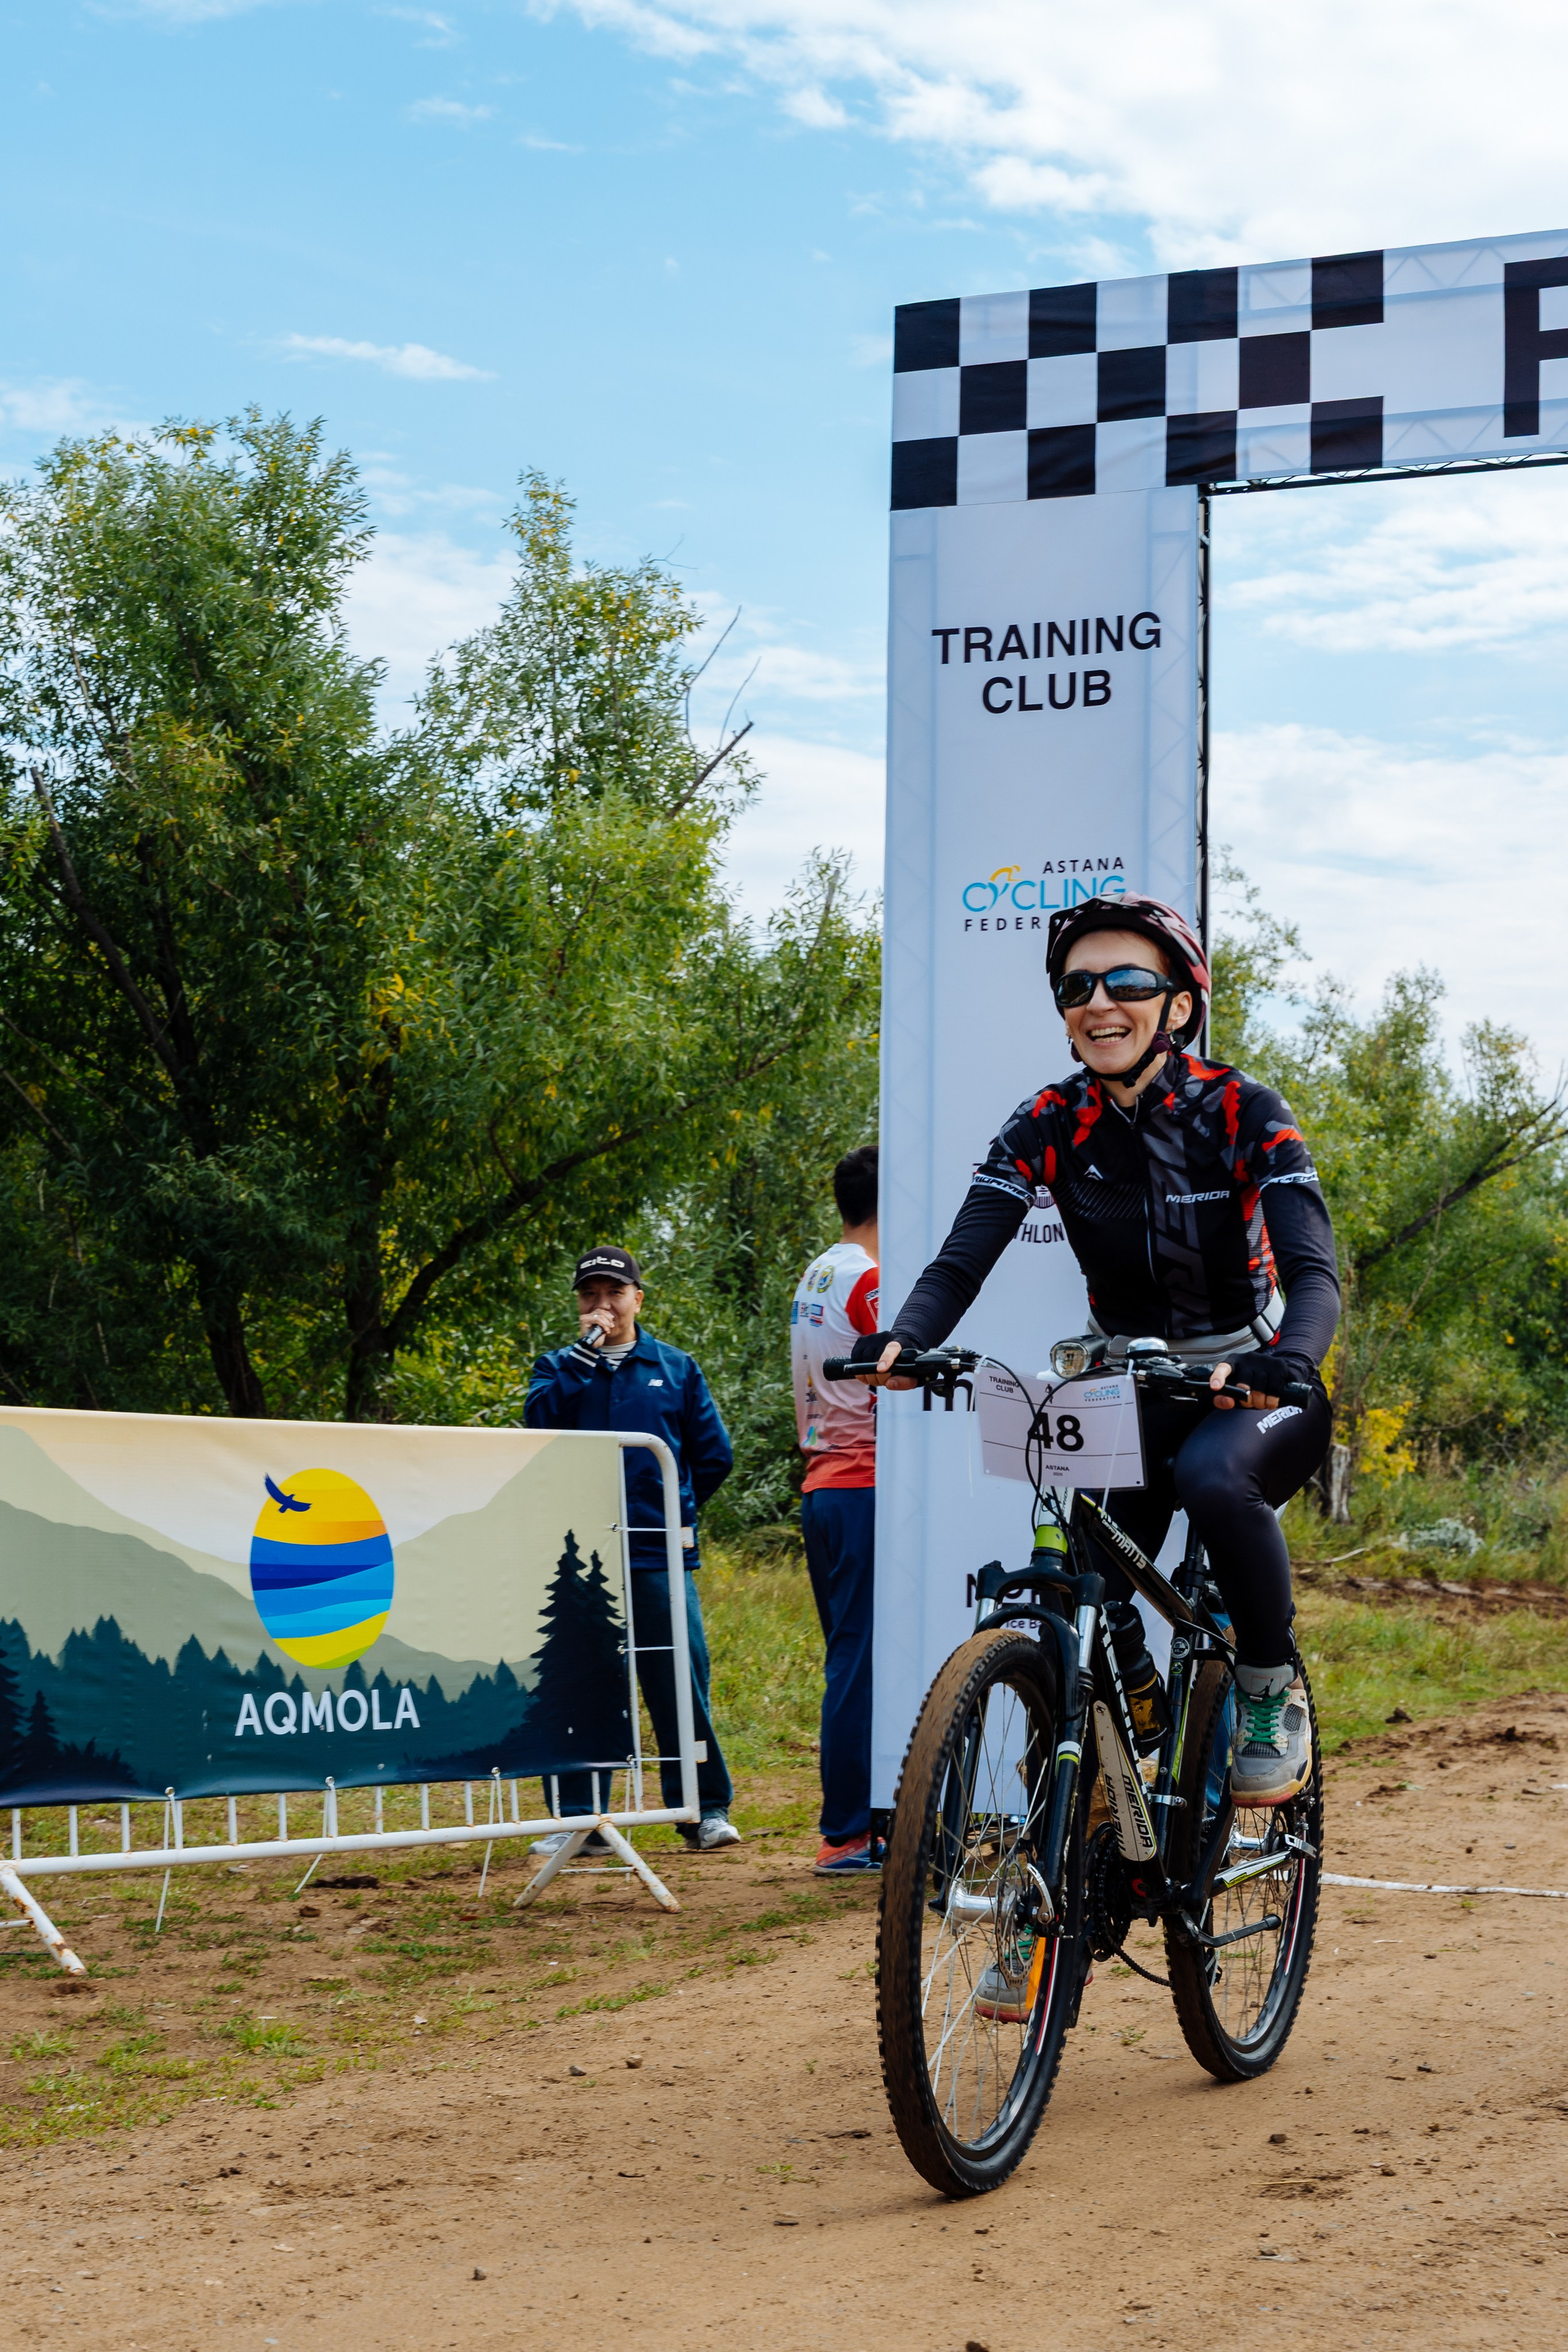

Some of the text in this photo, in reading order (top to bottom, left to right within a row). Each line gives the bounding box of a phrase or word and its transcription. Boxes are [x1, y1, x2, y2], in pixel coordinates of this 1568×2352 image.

[931, 611, 1162, 665] TRAINING
[982, 669, 1112, 714] CLUB
[1042, 857, 1124, 874] ASTANA
[962, 875, 1126, 912] CYCLING
[964, 916, 1049, 932] FEDER
[1166, 1191, 1230, 1204] MERIDA
[989, 1376, 1020, 1388] TRAINING
[996, 1384, 1014, 1393] CLUB
[1027, 1412, 1084, 1452] 48
[1256, 1405, 1303, 1434] MERIDA
[235, 1688, 421, 1736] AQMOLA
[1121, 1774, 1153, 1848] MERIDA
